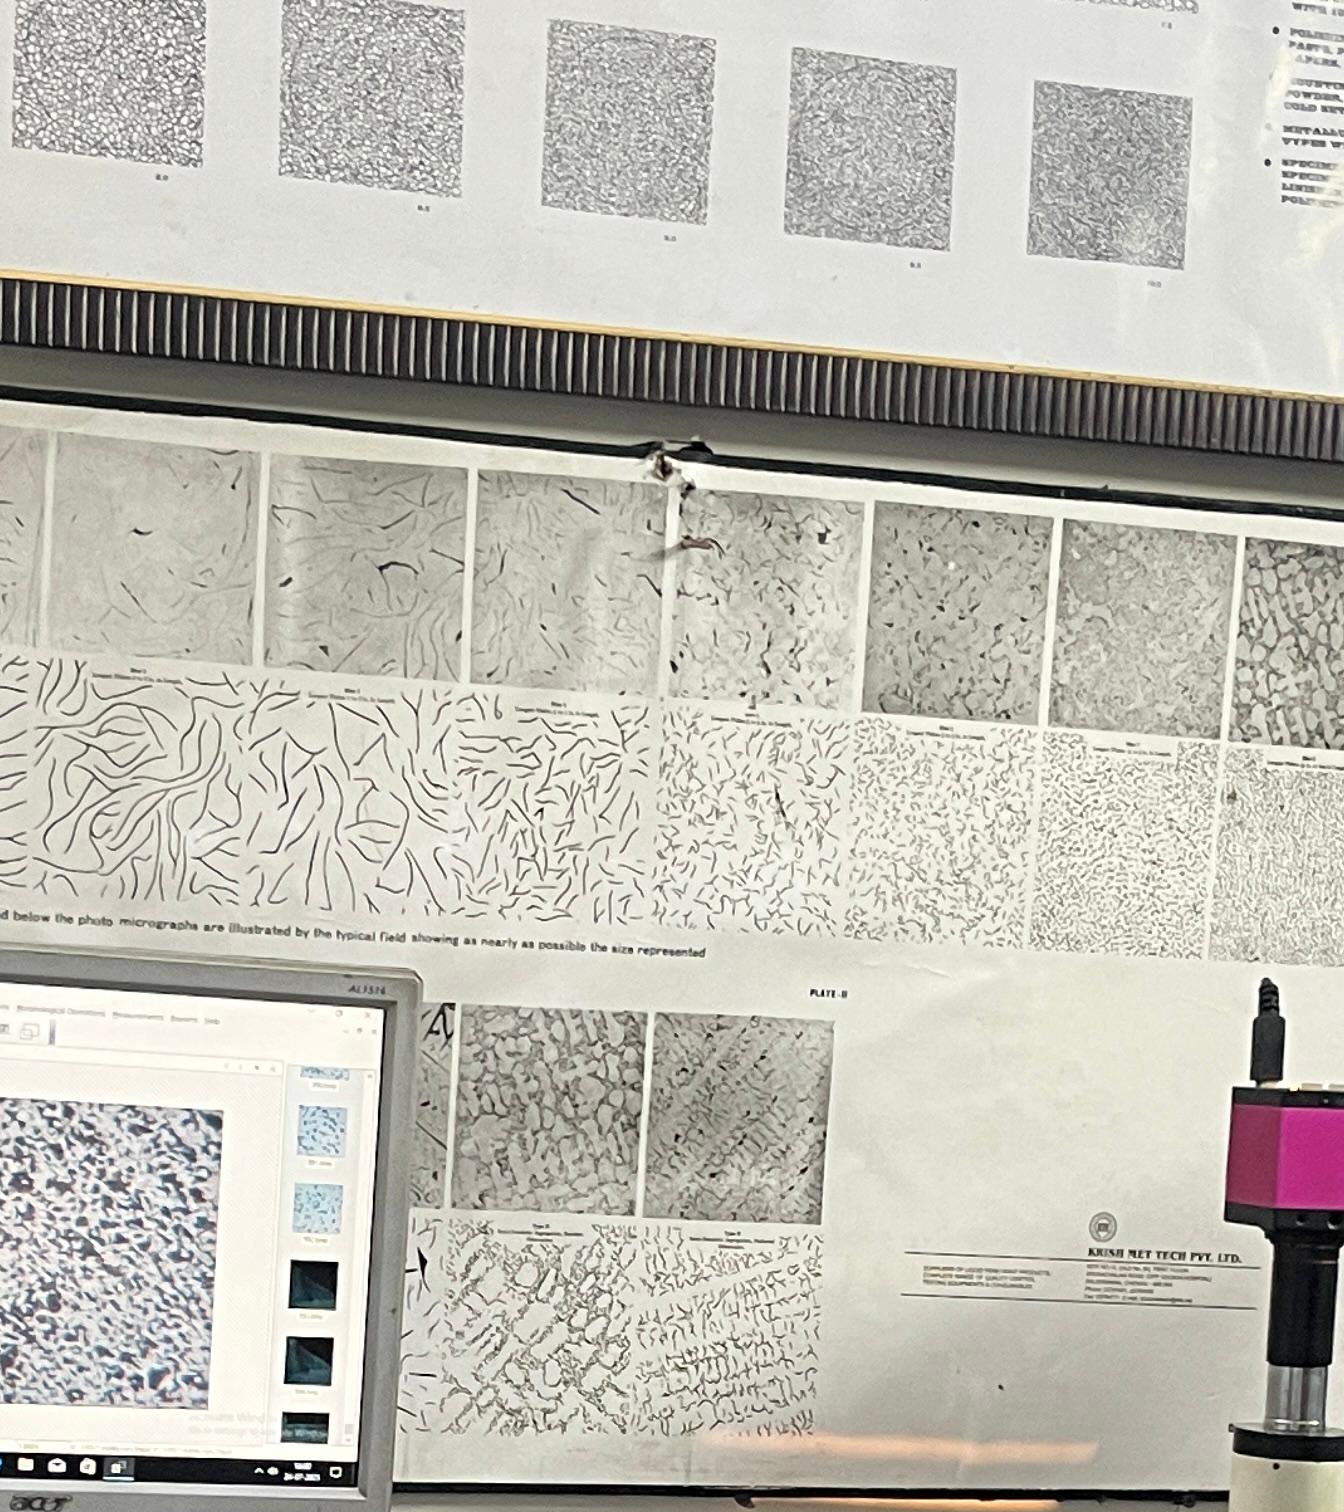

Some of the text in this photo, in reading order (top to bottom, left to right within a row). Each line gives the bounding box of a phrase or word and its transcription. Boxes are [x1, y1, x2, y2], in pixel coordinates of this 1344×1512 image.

[13, 908, 51, 924] below
[56, 911, 75, 925] the
[78, 913, 114, 928] photo
[119, 917, 199, 933] micrographs
[203, 922, 225, 933] are
[228, 922, 292, 938] illustrated
[295, 924, 309, 939] by
[313, 927, 333, 939] the
[336, 928, 376, 943] typical
[380, 931, 407, 944] field
[411, 934, 460, 947] showing
[463, 937, 478, 946] as
[480, 937, 519, 951] nearly
[521, 940, 535, 950] as
[538, 940, 587, 953] possible
[590, 941, 609, 953] the
[636, 946, 707, 959] represented
